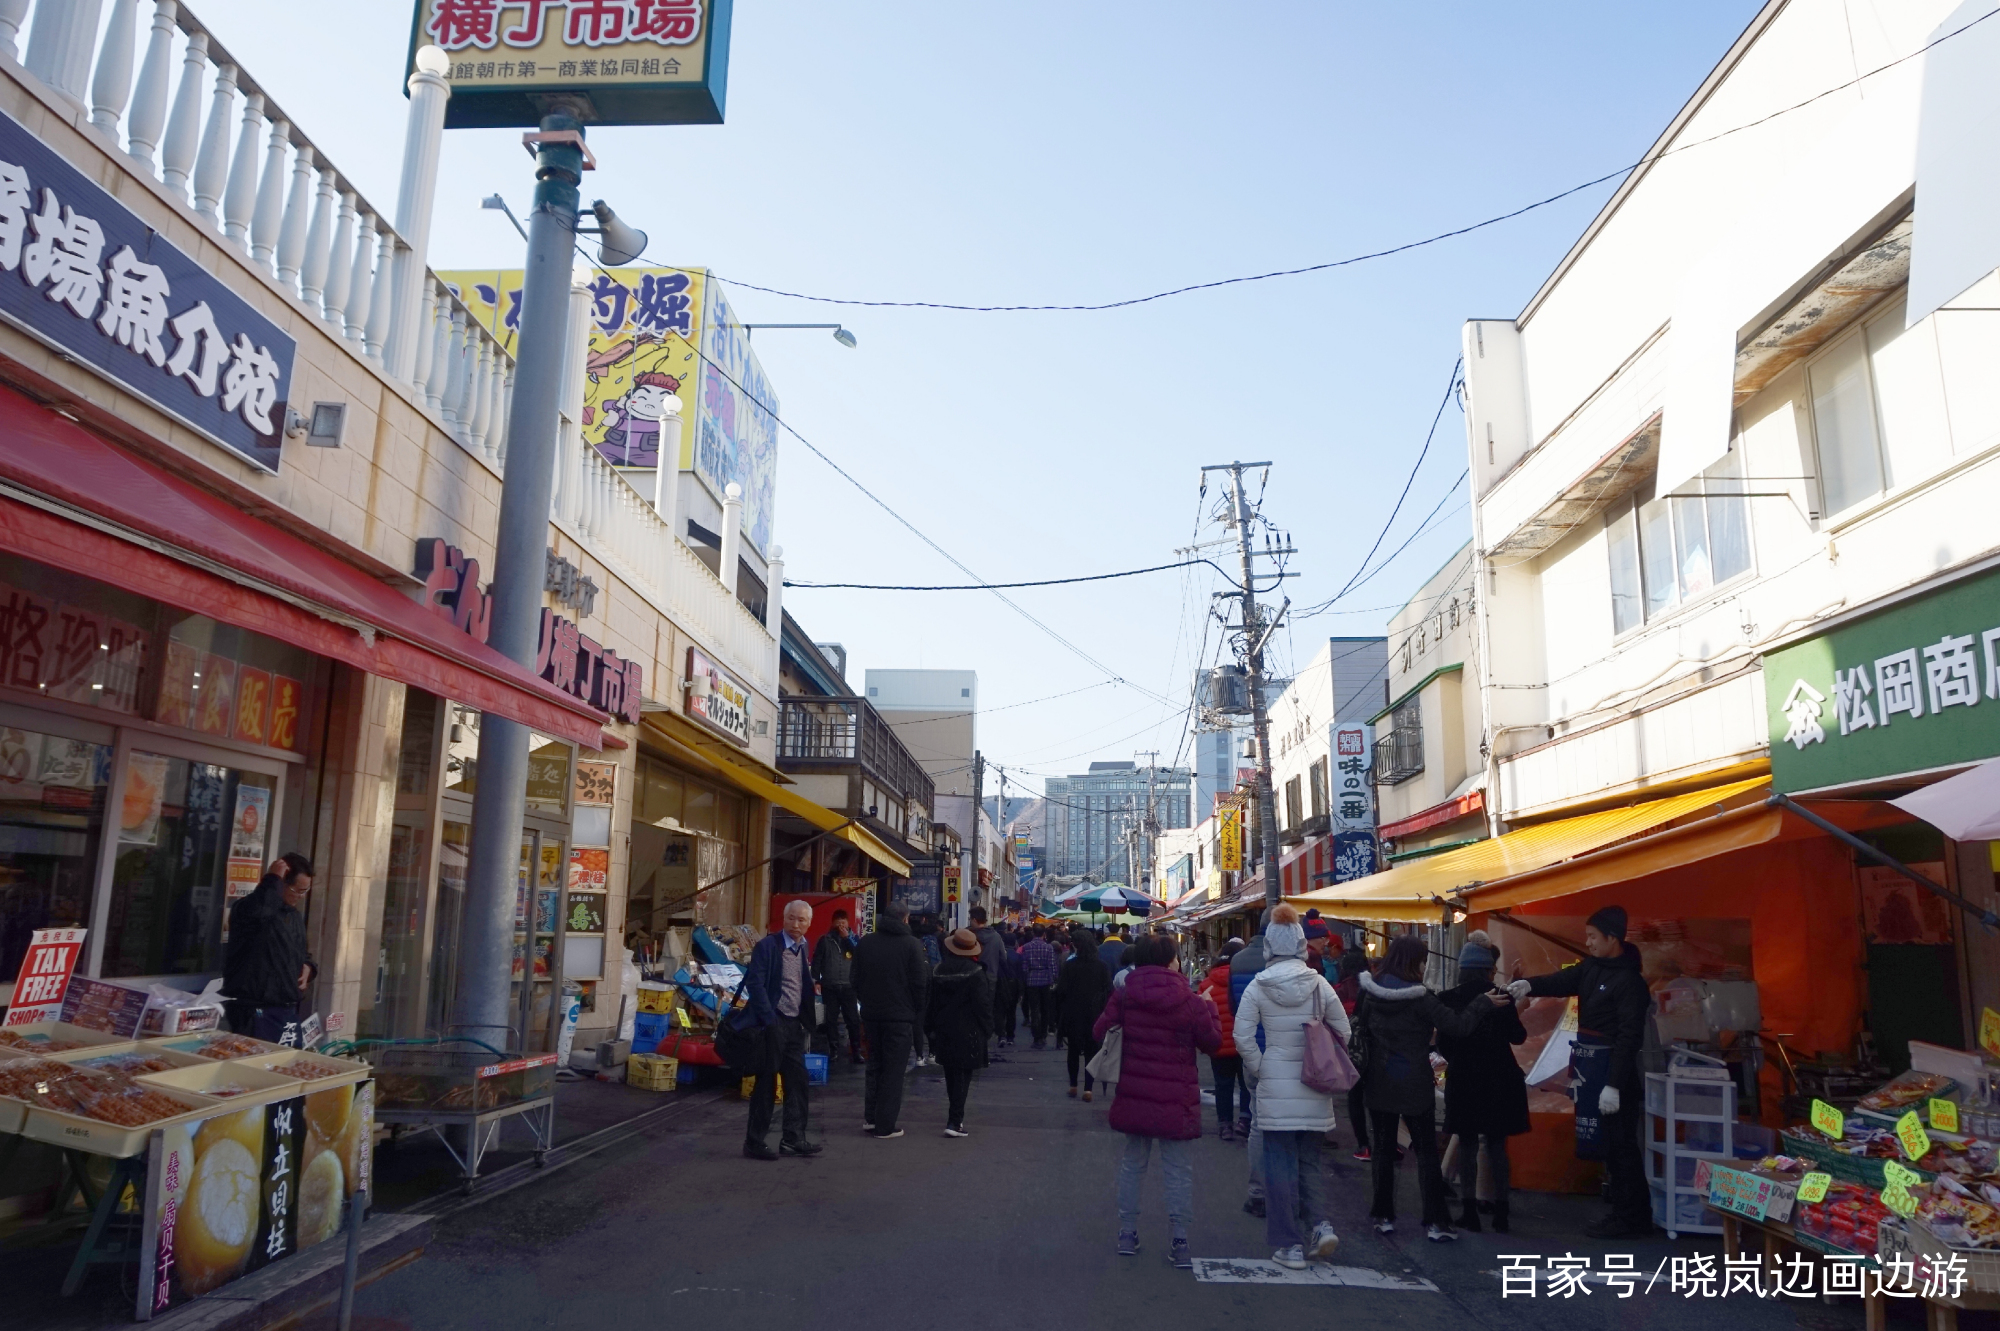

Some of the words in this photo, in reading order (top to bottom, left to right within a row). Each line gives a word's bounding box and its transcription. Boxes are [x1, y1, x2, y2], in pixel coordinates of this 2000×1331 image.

[1338, 756, 1366, 819] 味の一番
[944, 868, 960, 877] 500
[32, 947, 69, 975] TAX
[18, 974, 65, 1005] FREE
[6, 1008, 38, 1026] SHOP
[1901, 1125, 1918, 1154] 756
[266, 1104, 294, 1261] 帆立貝柱
